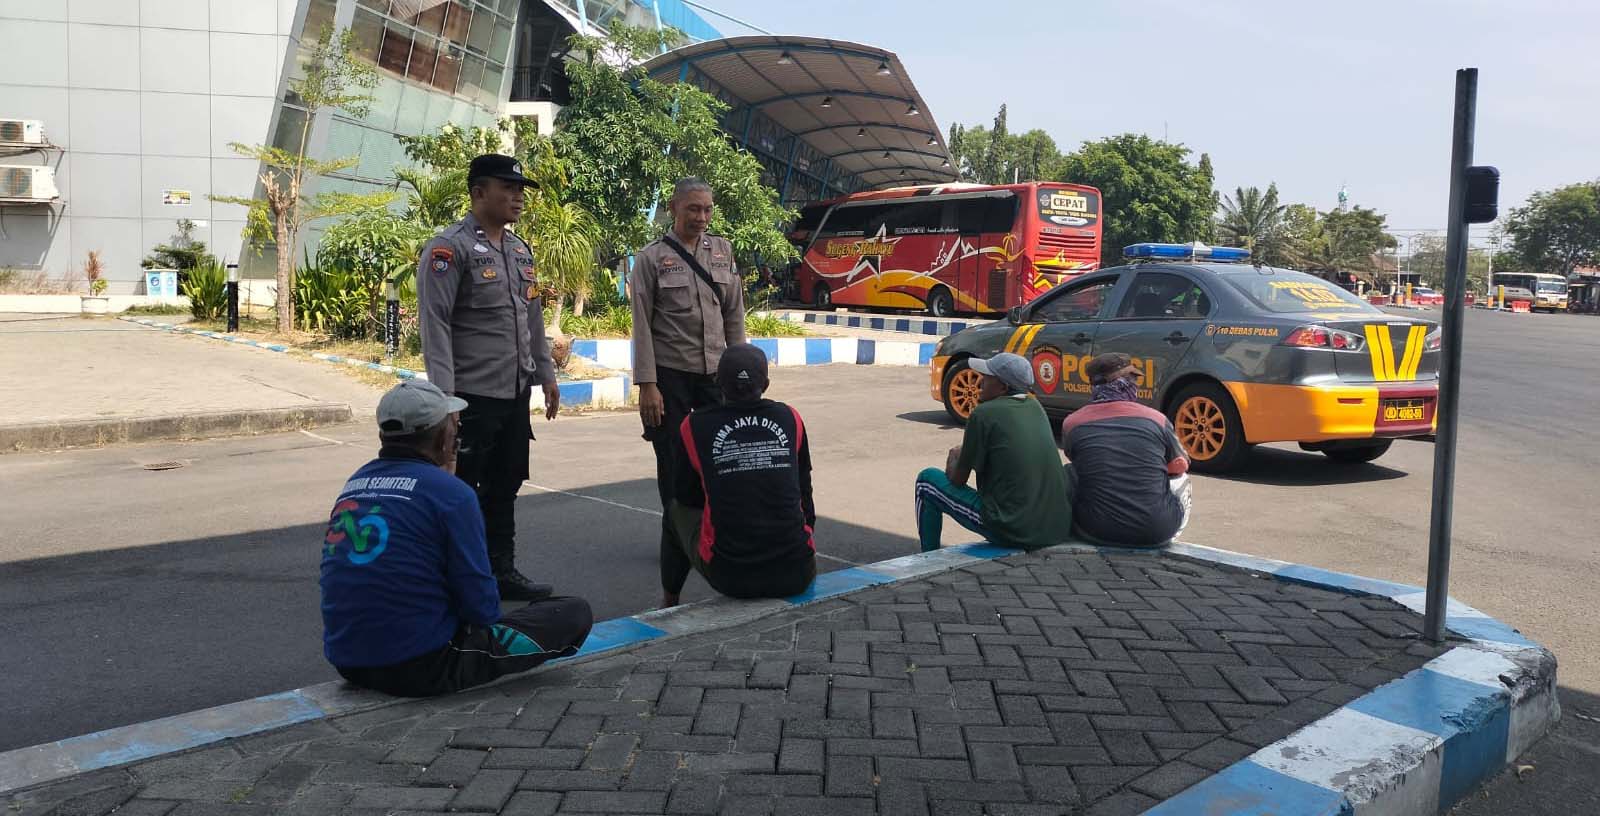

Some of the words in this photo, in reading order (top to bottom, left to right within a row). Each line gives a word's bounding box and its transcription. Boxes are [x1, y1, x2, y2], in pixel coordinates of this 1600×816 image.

[1053, 197, 1085, 209] CEPAT
[1062, 353, 1154, 388] POSI
[712, 424, 734, 455] PRIMA
[734, 416, 759, 430] JAYA
[761, 418, 790, 447] DIESEL
